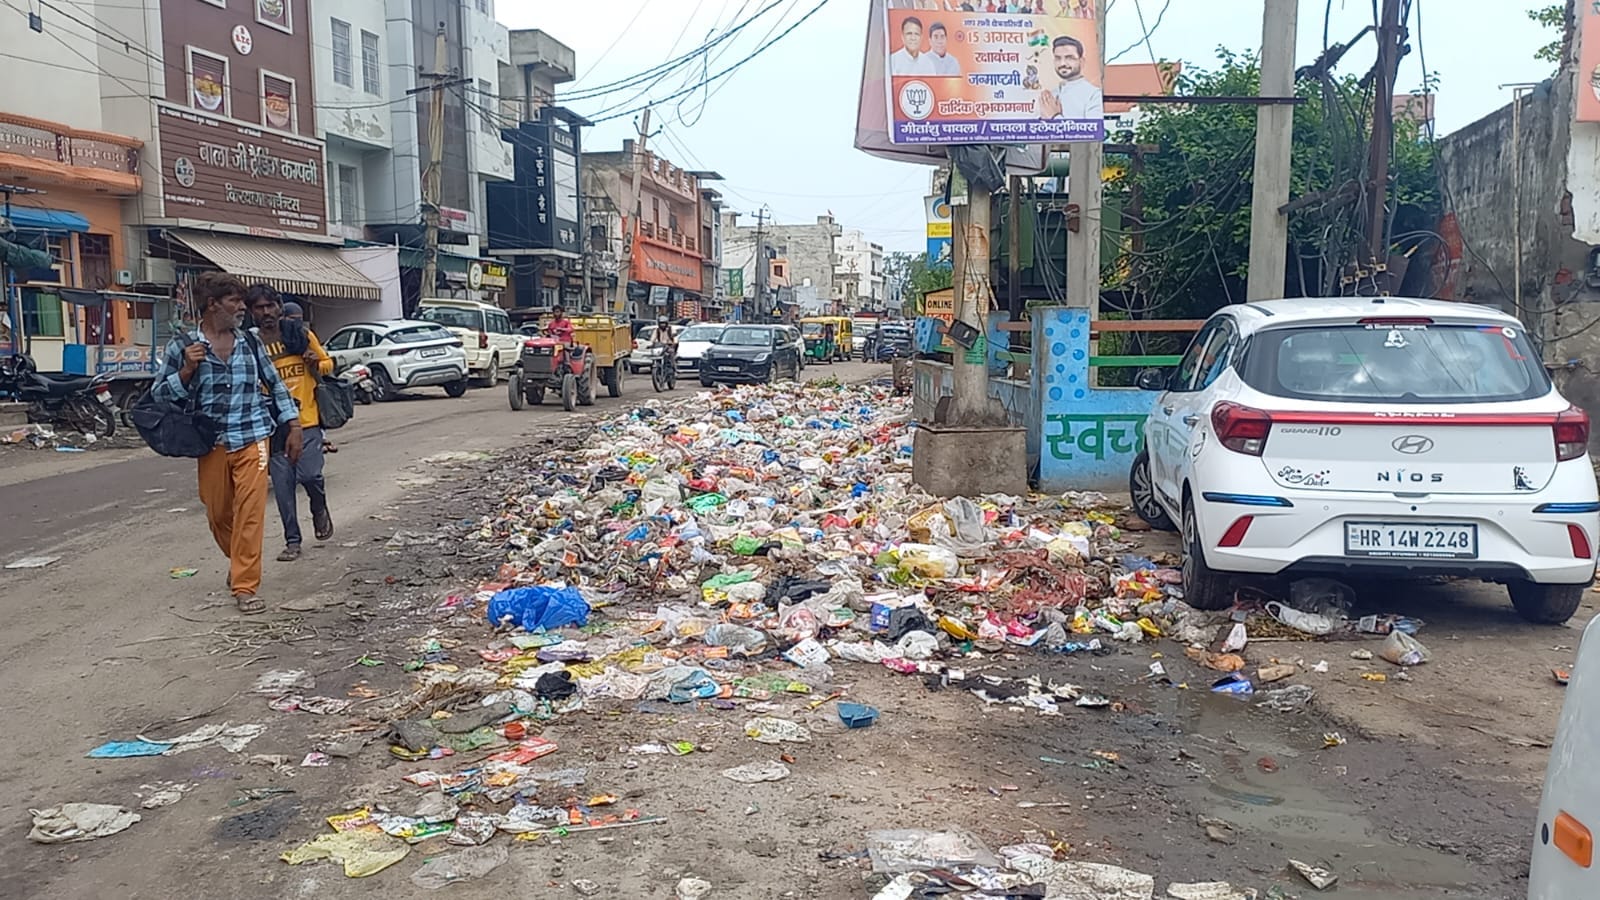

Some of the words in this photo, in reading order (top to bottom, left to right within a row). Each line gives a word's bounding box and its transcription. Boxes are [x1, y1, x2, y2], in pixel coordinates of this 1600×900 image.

[968, 31, 980, 43] 15
[983, 31, 1024, 44] अगस्त
[974, 48, 1019, 63] रक्षाबंधन
[968, 69, 1021, 86] जन्माष्टमी
[993, 89, 1004, 99] की
[900, 121, 940, 137] गीतांशु
[942, 123, 978, 133] चावला
[989, 122, 1026, 133] चावला
[198, 141, 230, 168] बाला
[231, 142, 248, 171] जी
[280, 158, 318, 185] कम्पनी
[927, 300, 953, 309] ONLINE
[279, 364, 305, 379] IKE
[1360, 529, 1381, 547] HR
[1388, 530, 1419, 547] 14W
[1424, 531, 1469, 548] 2248
